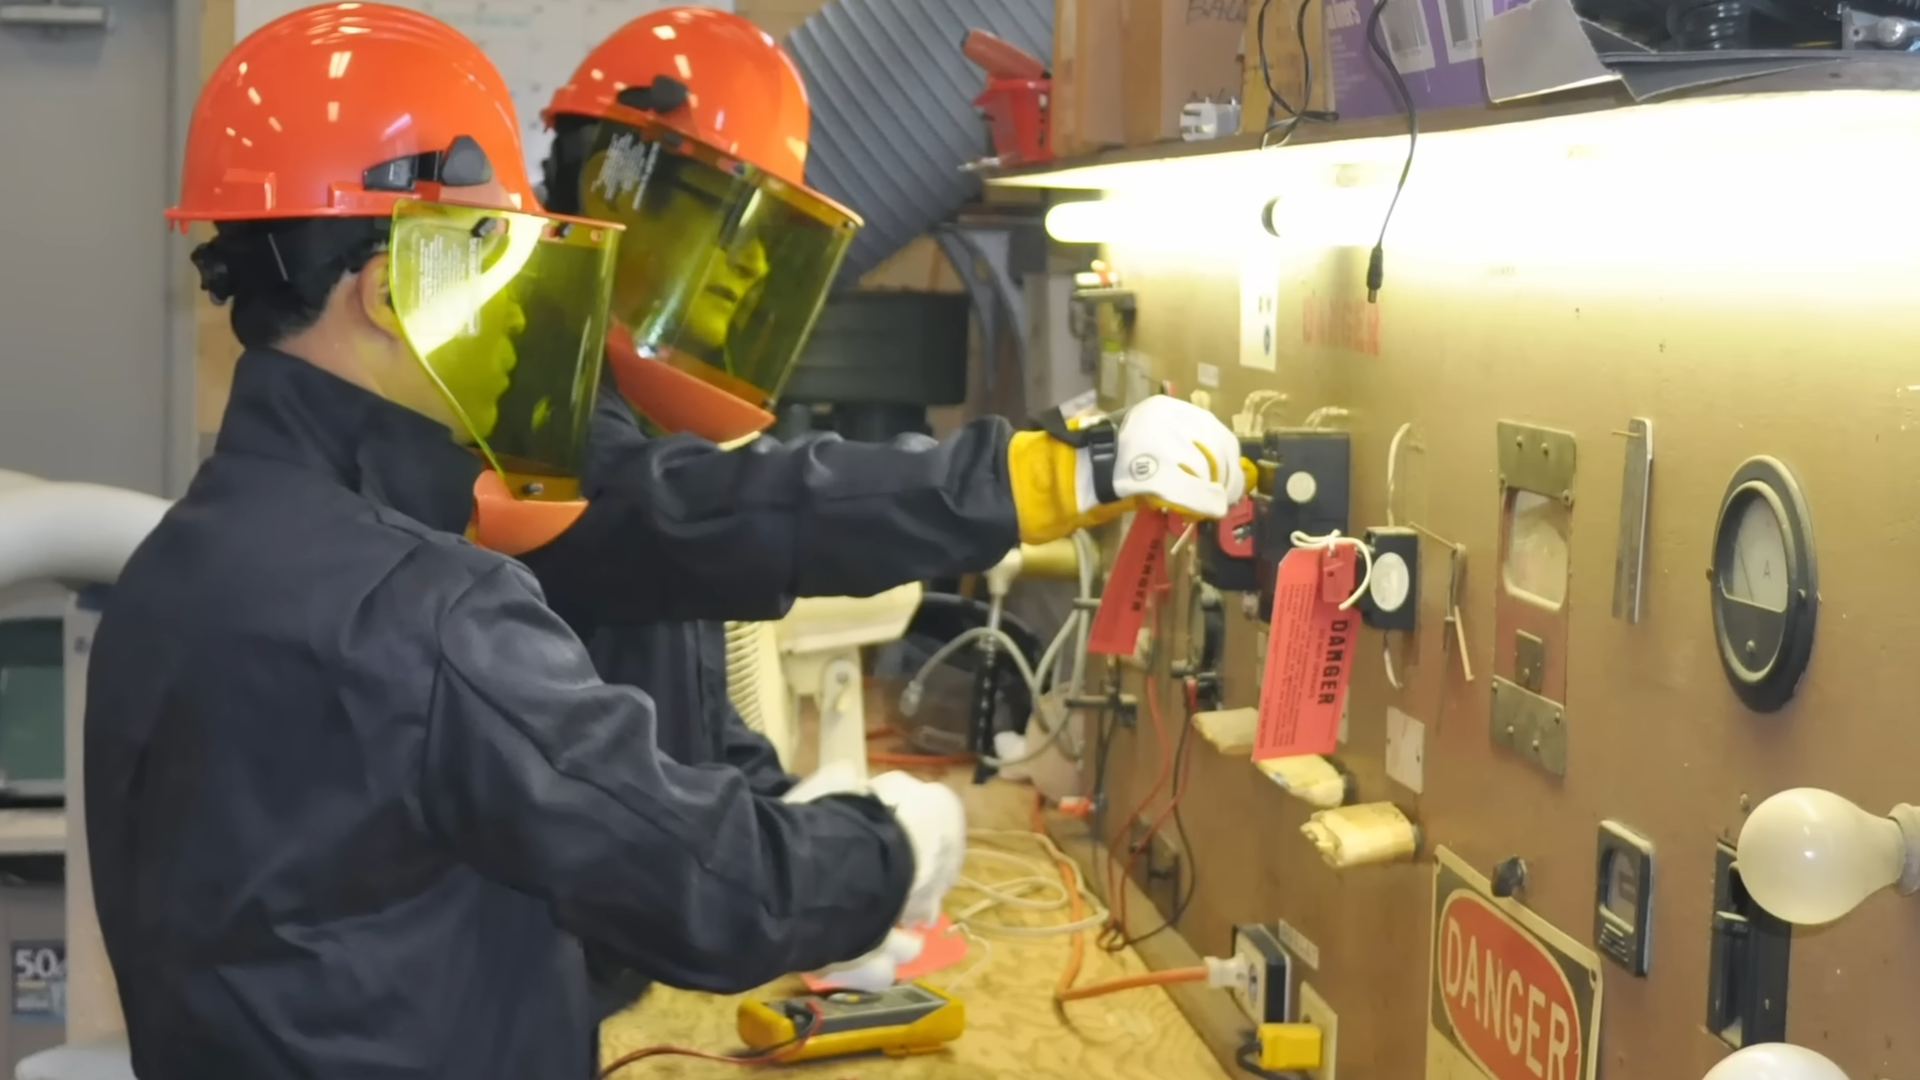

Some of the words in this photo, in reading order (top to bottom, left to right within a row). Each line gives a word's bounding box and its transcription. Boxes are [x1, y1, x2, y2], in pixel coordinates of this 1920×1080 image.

[1763, 559, 1772, 581] A
[1316, 618, 1350, 706] DANGER
[1445, 916, 1571, 1080] DANGER
